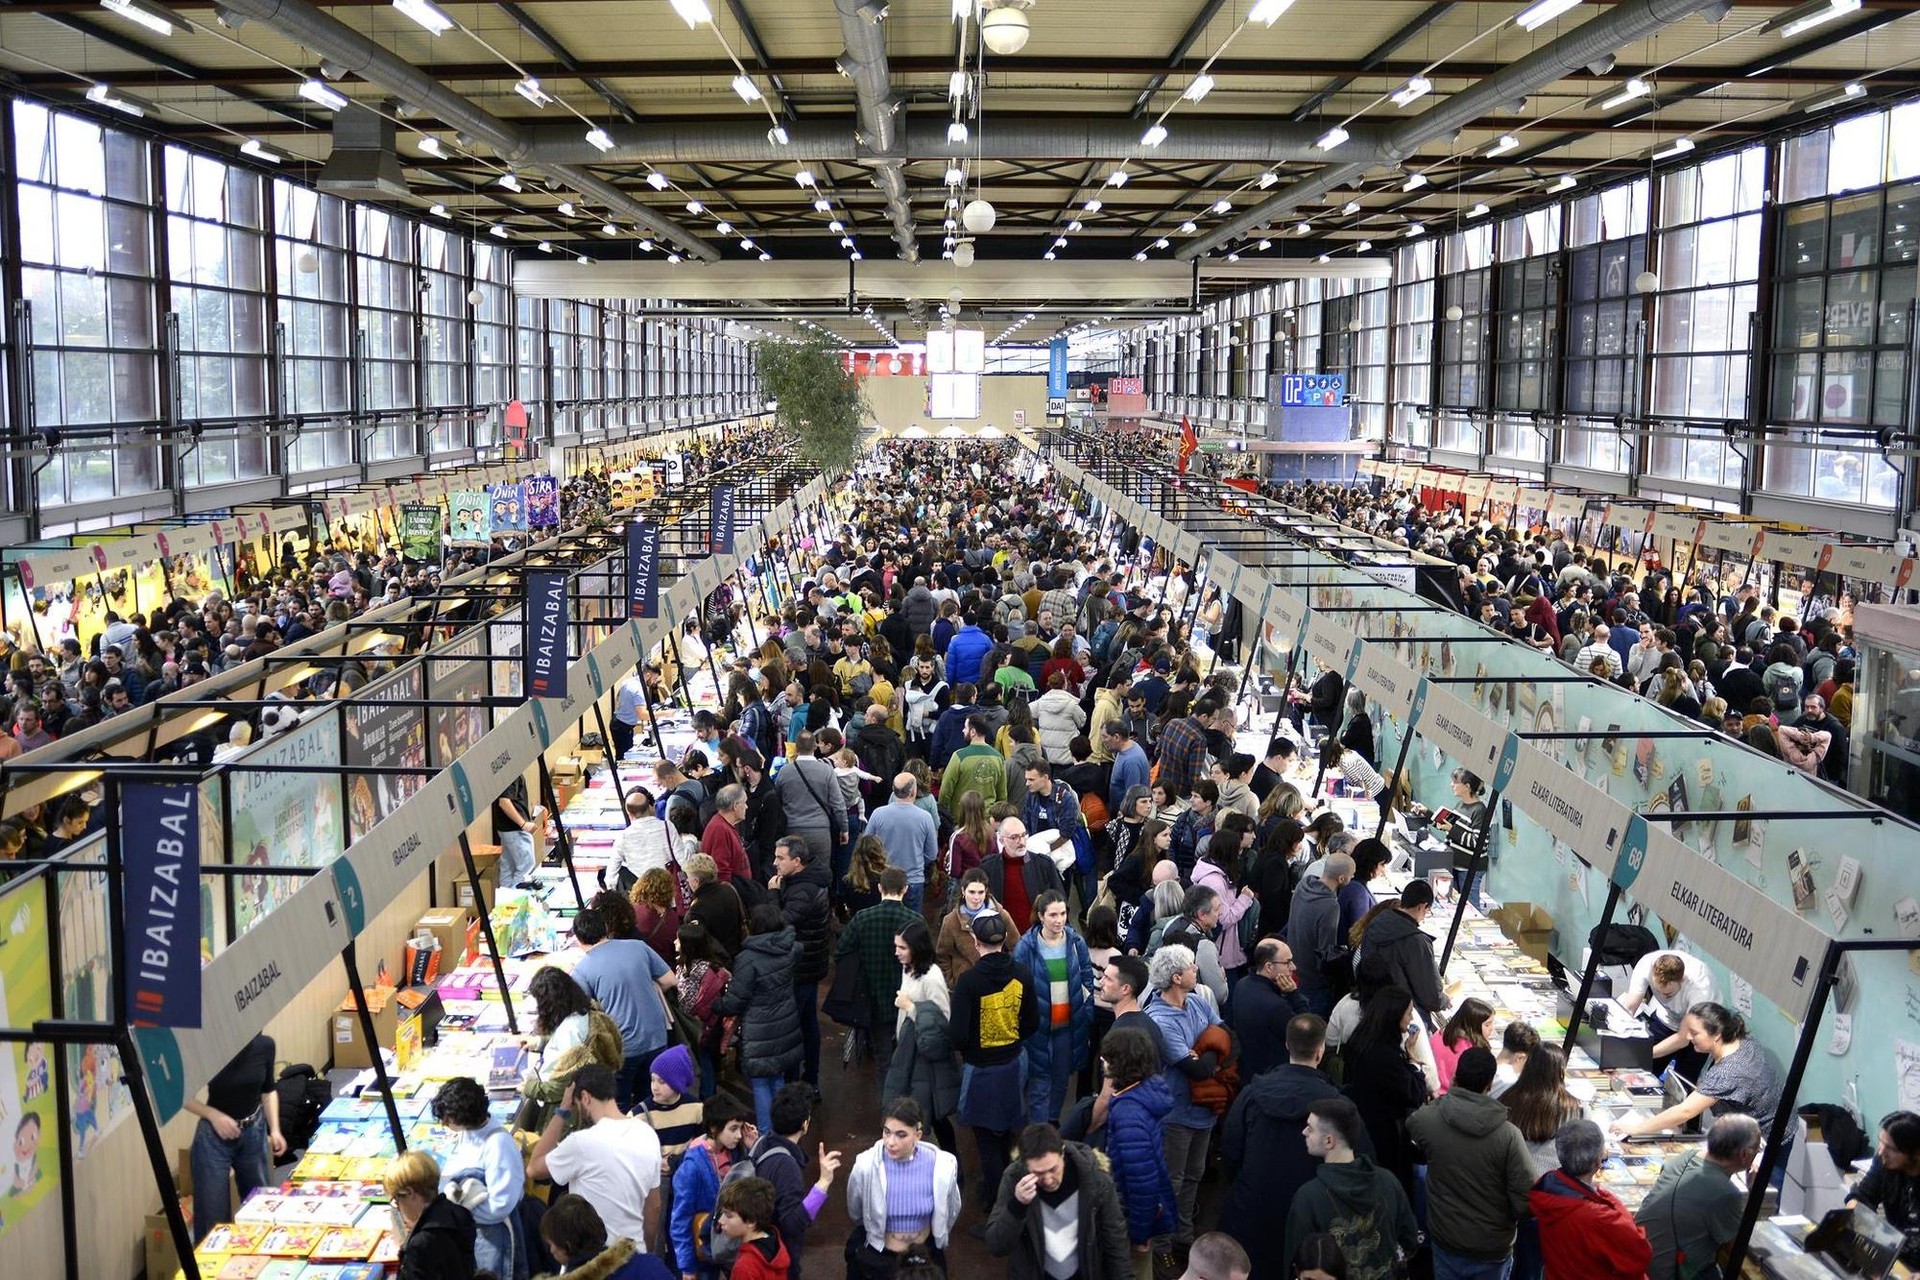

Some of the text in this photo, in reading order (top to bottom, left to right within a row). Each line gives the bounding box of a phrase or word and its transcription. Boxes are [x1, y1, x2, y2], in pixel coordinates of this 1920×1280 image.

[1112, 379, 1121, 394] 03
[1285, 377, 1303, 403] 02
[1051, 401, 1064, 410] DA!
[716, 487, 733, 542] IBAIZABAL
[634, 527, 656, 600] IBAIZABAL
[535, 577, 564, 675] IBAIZABAL
[1435, 713, 1473, 749] ELKAR LITERATURA
[1503, 759, 1513, 775] 67
[1531, 781, 1583, 829] ELKAR LITERATURA
[392, 832, 421, 867] IBAIZABAL
[1628, 846, 1642, 870] 68
[140, 791, 190, 982] IBAIZABAL
[346, 886, 358, 909] 2
[1670, 881, 1753, 951] ELKAR LITERATURA
[234, 960, 281, 1013] IBAIZABAL
[158, 1053, 171, 1081] 1
